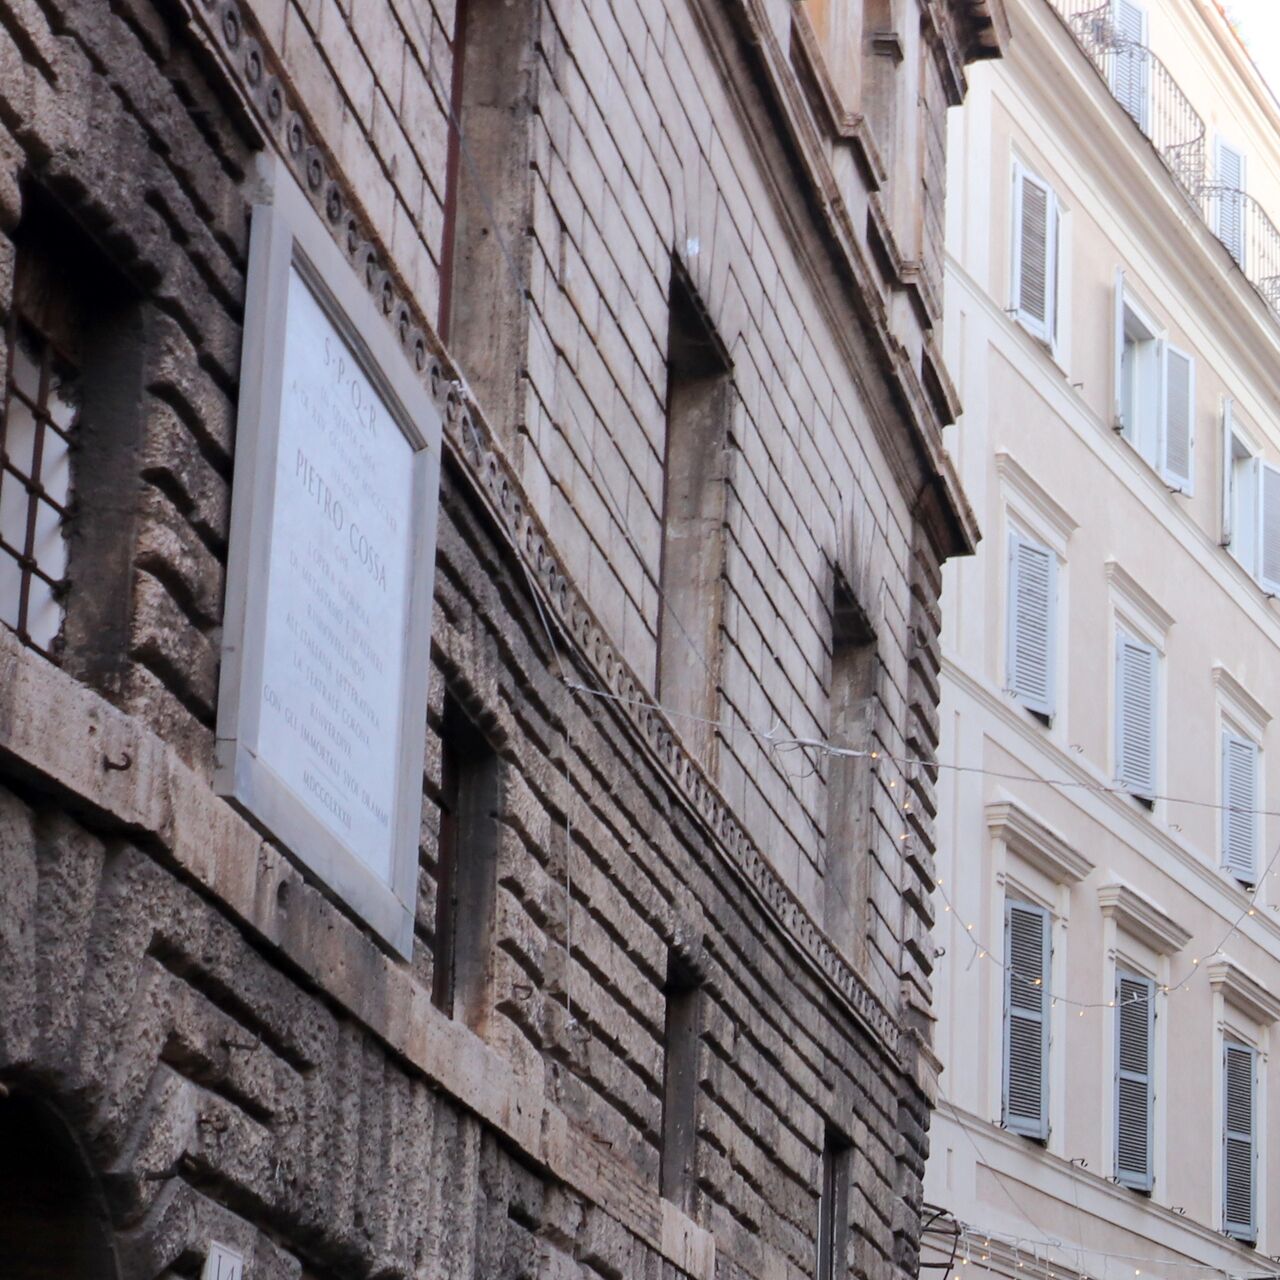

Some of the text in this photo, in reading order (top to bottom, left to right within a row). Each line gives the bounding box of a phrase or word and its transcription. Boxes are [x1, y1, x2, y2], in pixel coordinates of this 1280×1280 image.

[297, 449, 386, 591] PIETRO COSSA
[264, 685, 280, 712] CON
